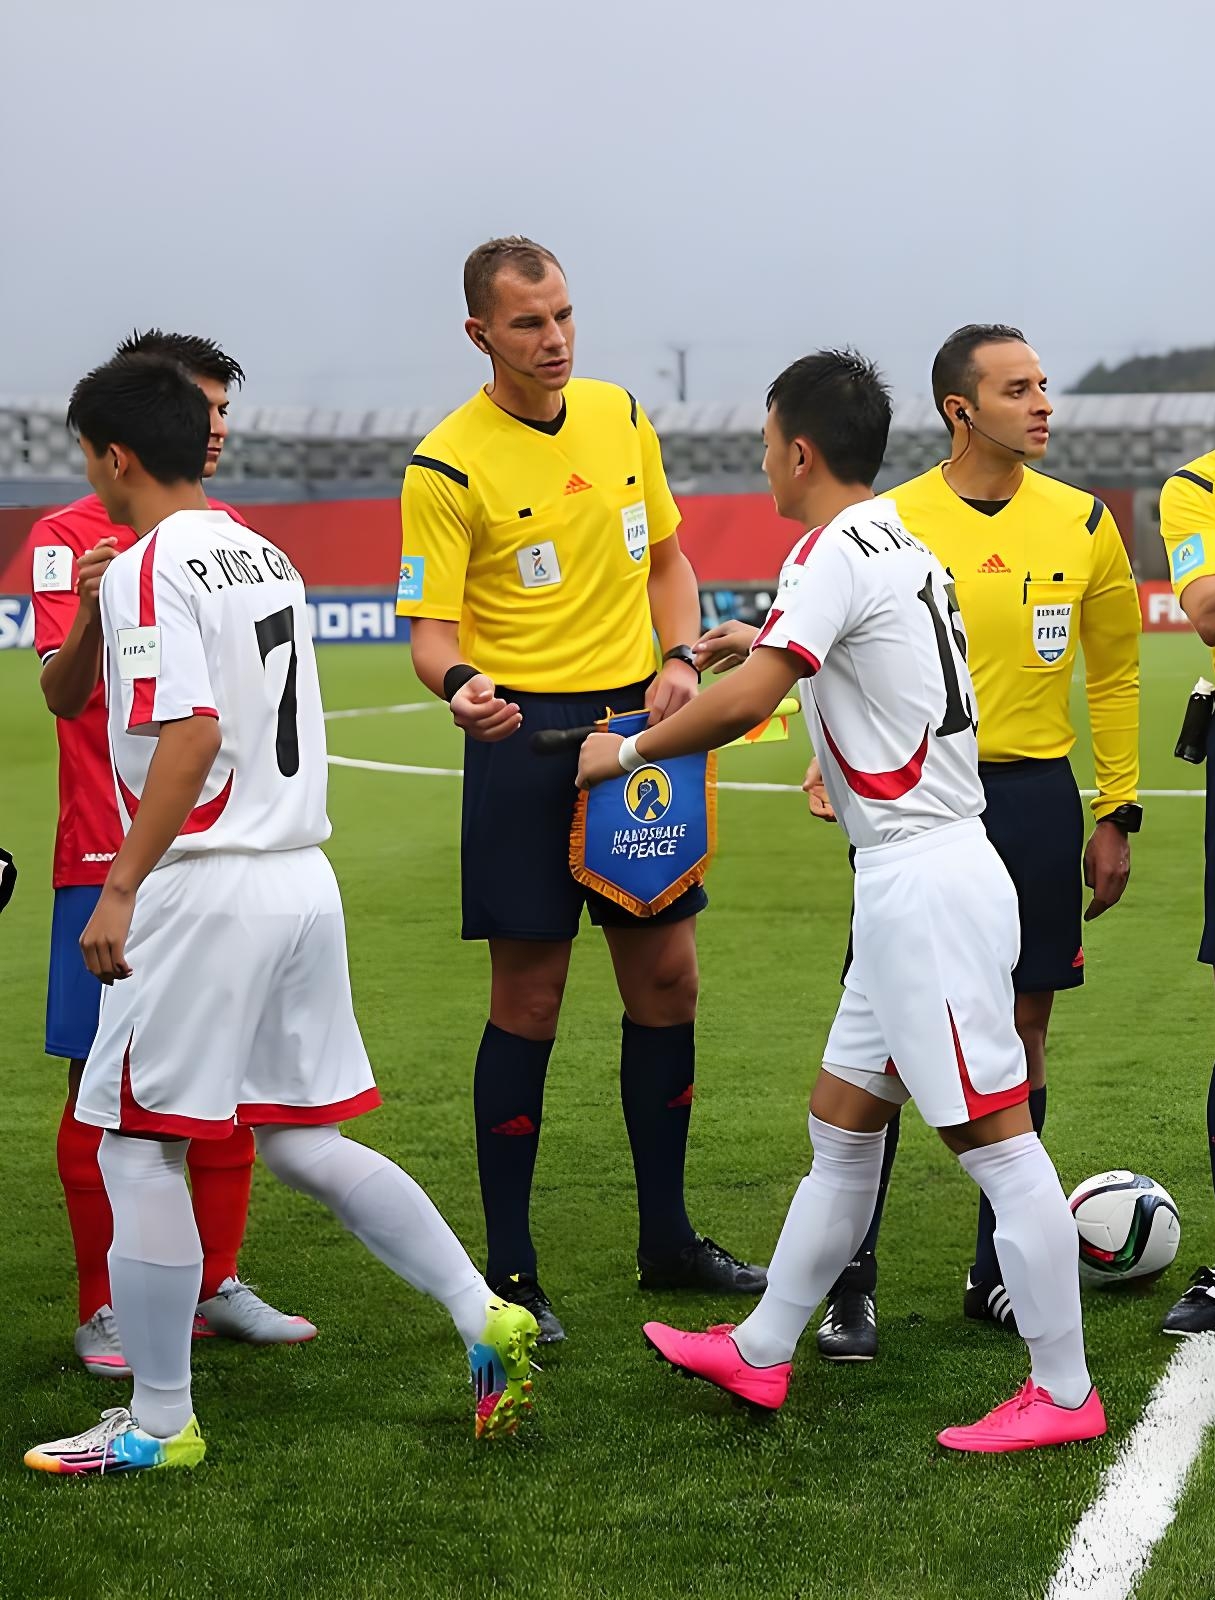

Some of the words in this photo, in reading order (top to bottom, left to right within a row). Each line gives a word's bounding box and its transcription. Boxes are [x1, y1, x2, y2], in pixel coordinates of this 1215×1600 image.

[1037, 625, 1067, 640] FIFA
[255, 605, 299, 777] 7
[627, 839, 678, 860] PEACE
